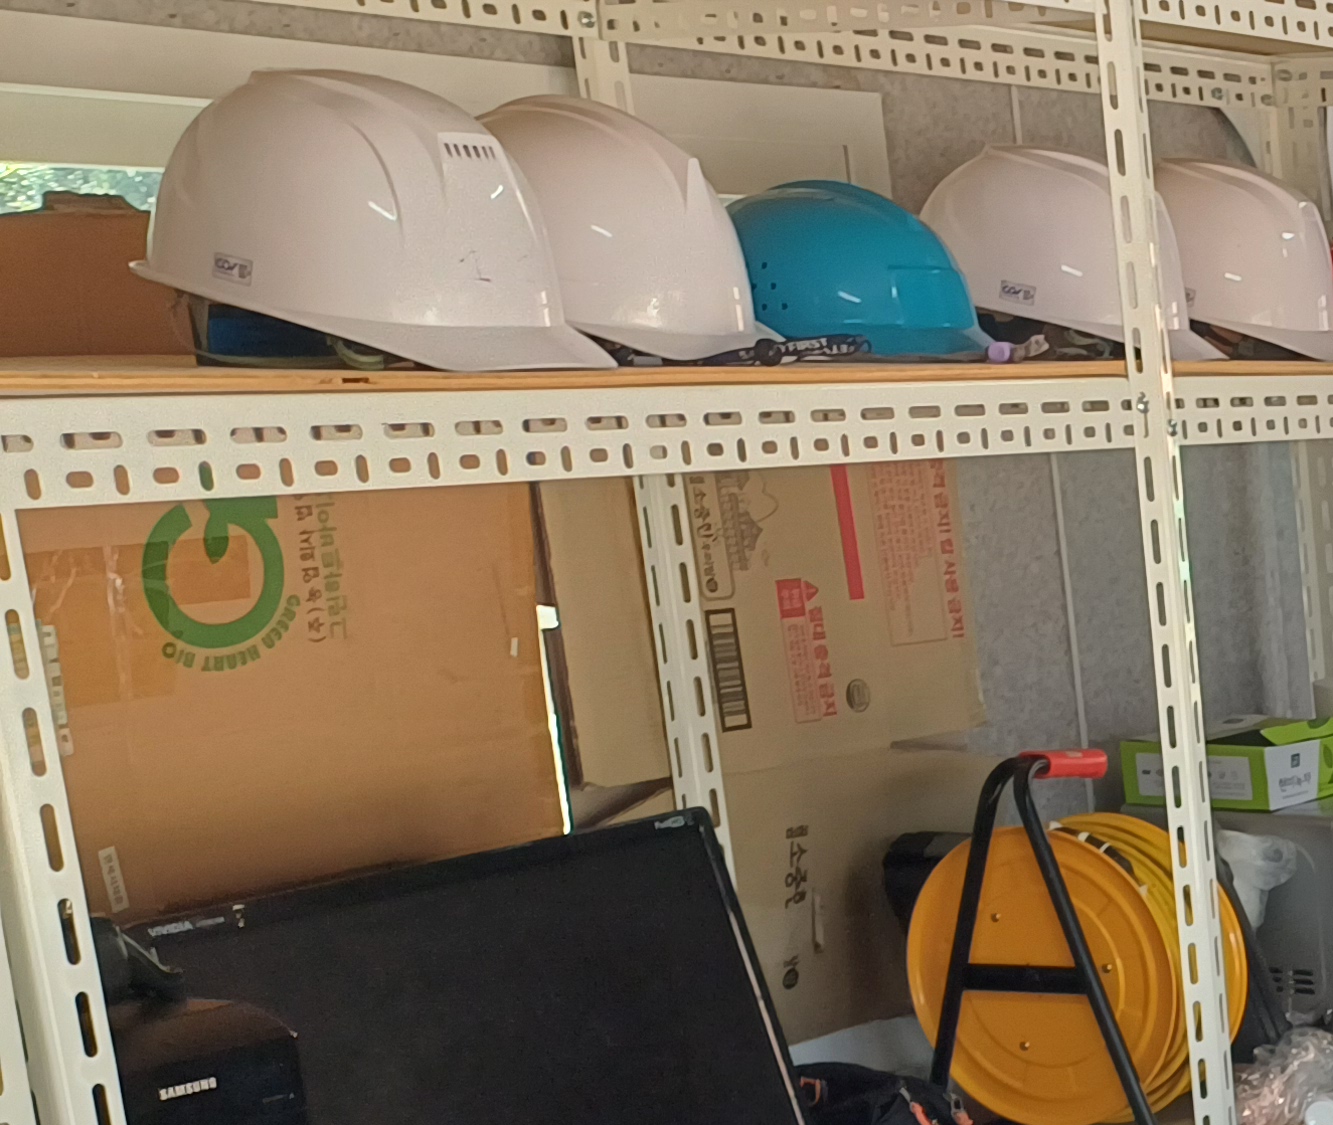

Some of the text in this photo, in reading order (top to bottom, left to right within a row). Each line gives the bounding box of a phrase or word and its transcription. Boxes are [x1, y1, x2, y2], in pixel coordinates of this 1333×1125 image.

[315, 495, 348, 640] 그린하트바이
[162, 594, 301, 672] GREEN HEART BIO
[159, 1076, 218, 1101] SAMSUNG
